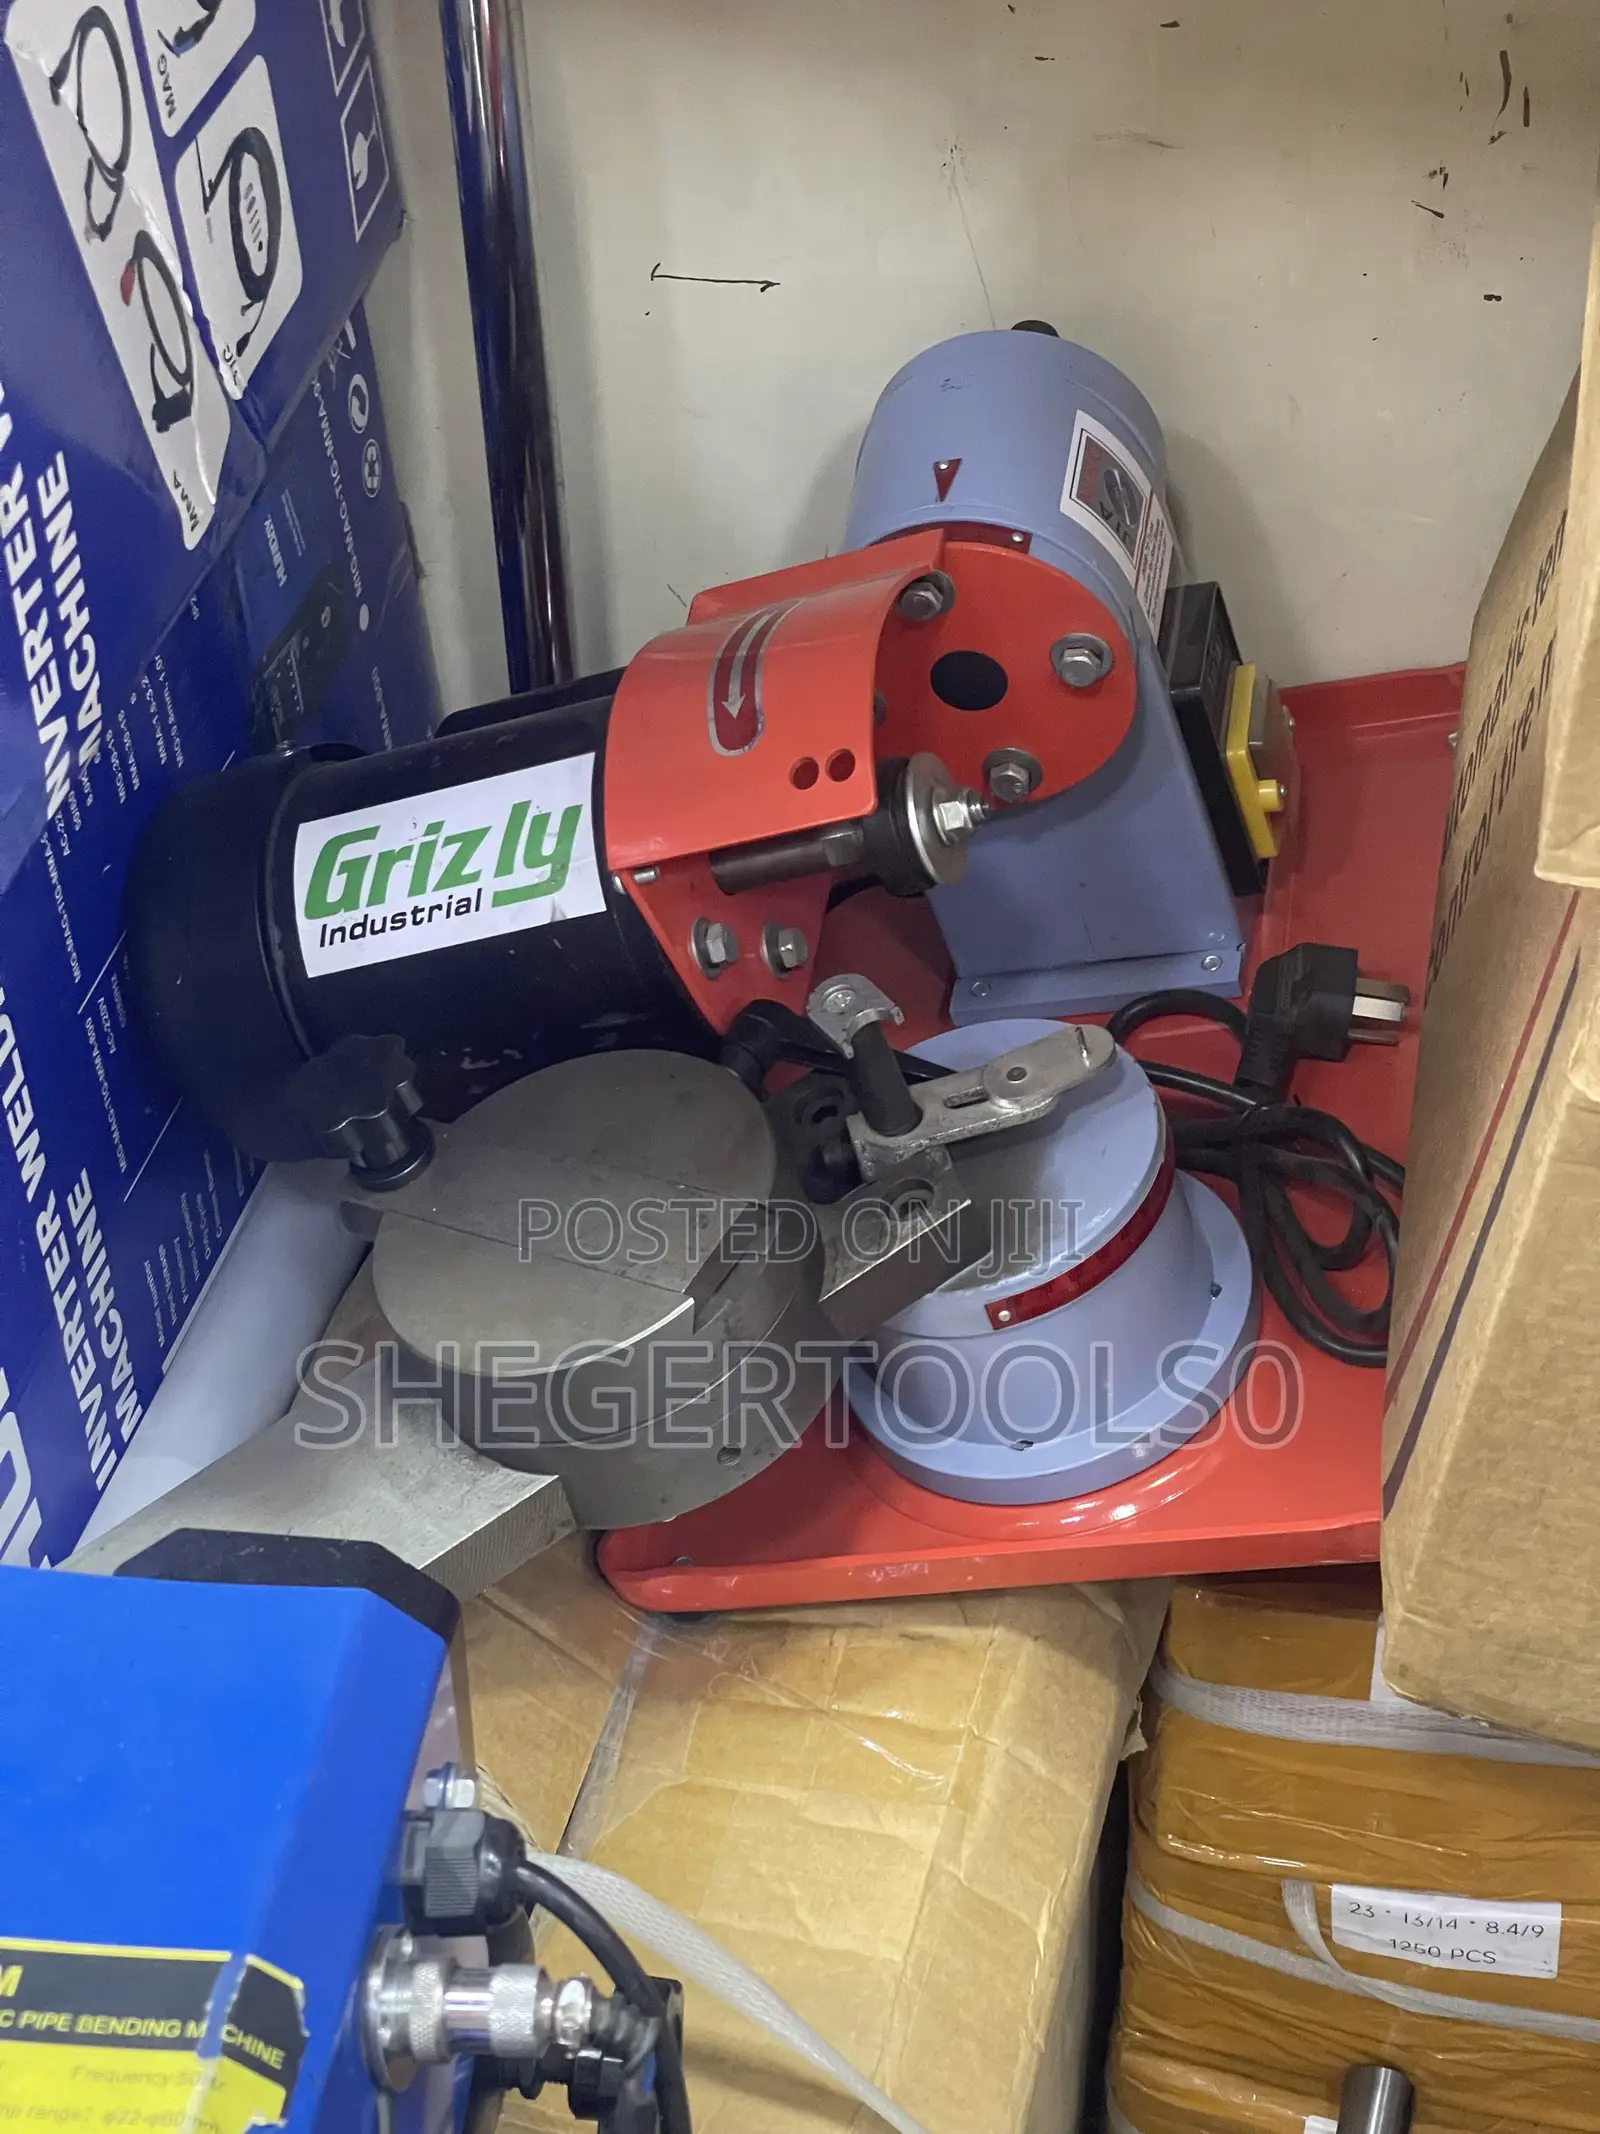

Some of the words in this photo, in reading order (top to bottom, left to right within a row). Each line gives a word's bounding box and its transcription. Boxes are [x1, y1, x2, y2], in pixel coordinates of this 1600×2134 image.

[157, 52, 177, 119] MAG
[173, 467, 200, 533] MMA
[304, 799, 584, 920] Grizly
[319, 888, 483, 949] Industrial
[67, 1167, 144, 1445] MACHINE
[36, 1189, 118, 1493] INVERTER
[1350, 1902, 1375, 1919] 23
[1404, 1911, 1458, 1931] 13/14
[1486, 1920, 1545, 1939] 8.4/9
[1451, 1948, 1497, 1965] PCS
[18, 2011, 73, 2031] PIPE
[75, 2014, 182, 2038] BENDING
[186, 2019, 287, 2071] MCHINE
[71, 2064, 170, 2088] Frequency
